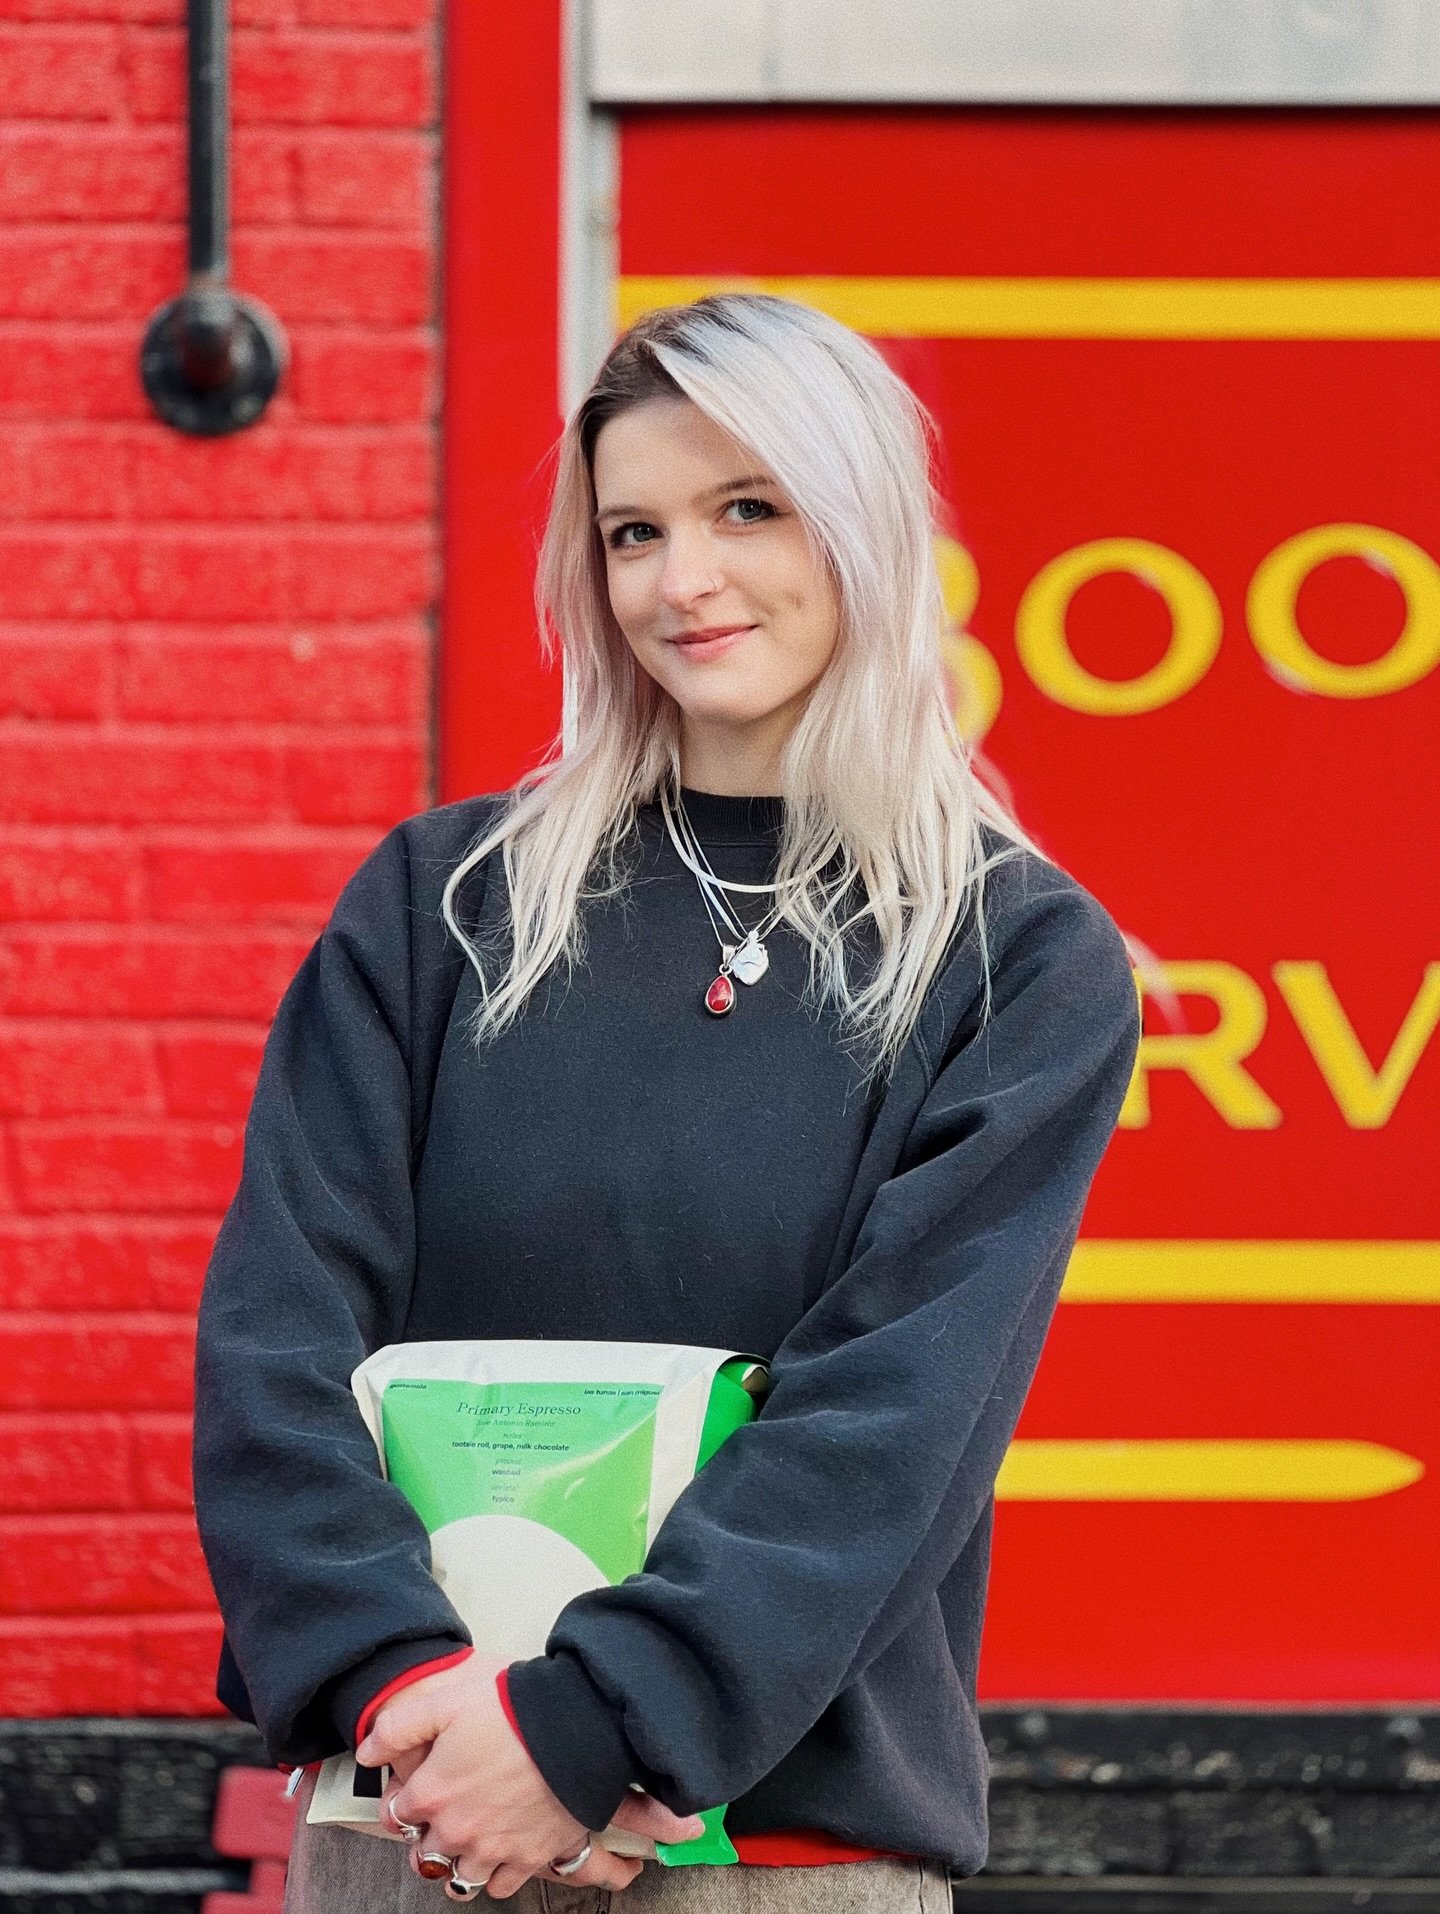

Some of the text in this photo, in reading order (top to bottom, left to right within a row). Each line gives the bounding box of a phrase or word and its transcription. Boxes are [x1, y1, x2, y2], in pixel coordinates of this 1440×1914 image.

[456, 1401, 582, 1418] Primary Espresso
[451, 1440, 476, 1448] tootsie
[492, 1442, 515, 1451] grape,
[533, 1443, 570, 1452] chocolate
[491, 1468, 521, 1476] washed
